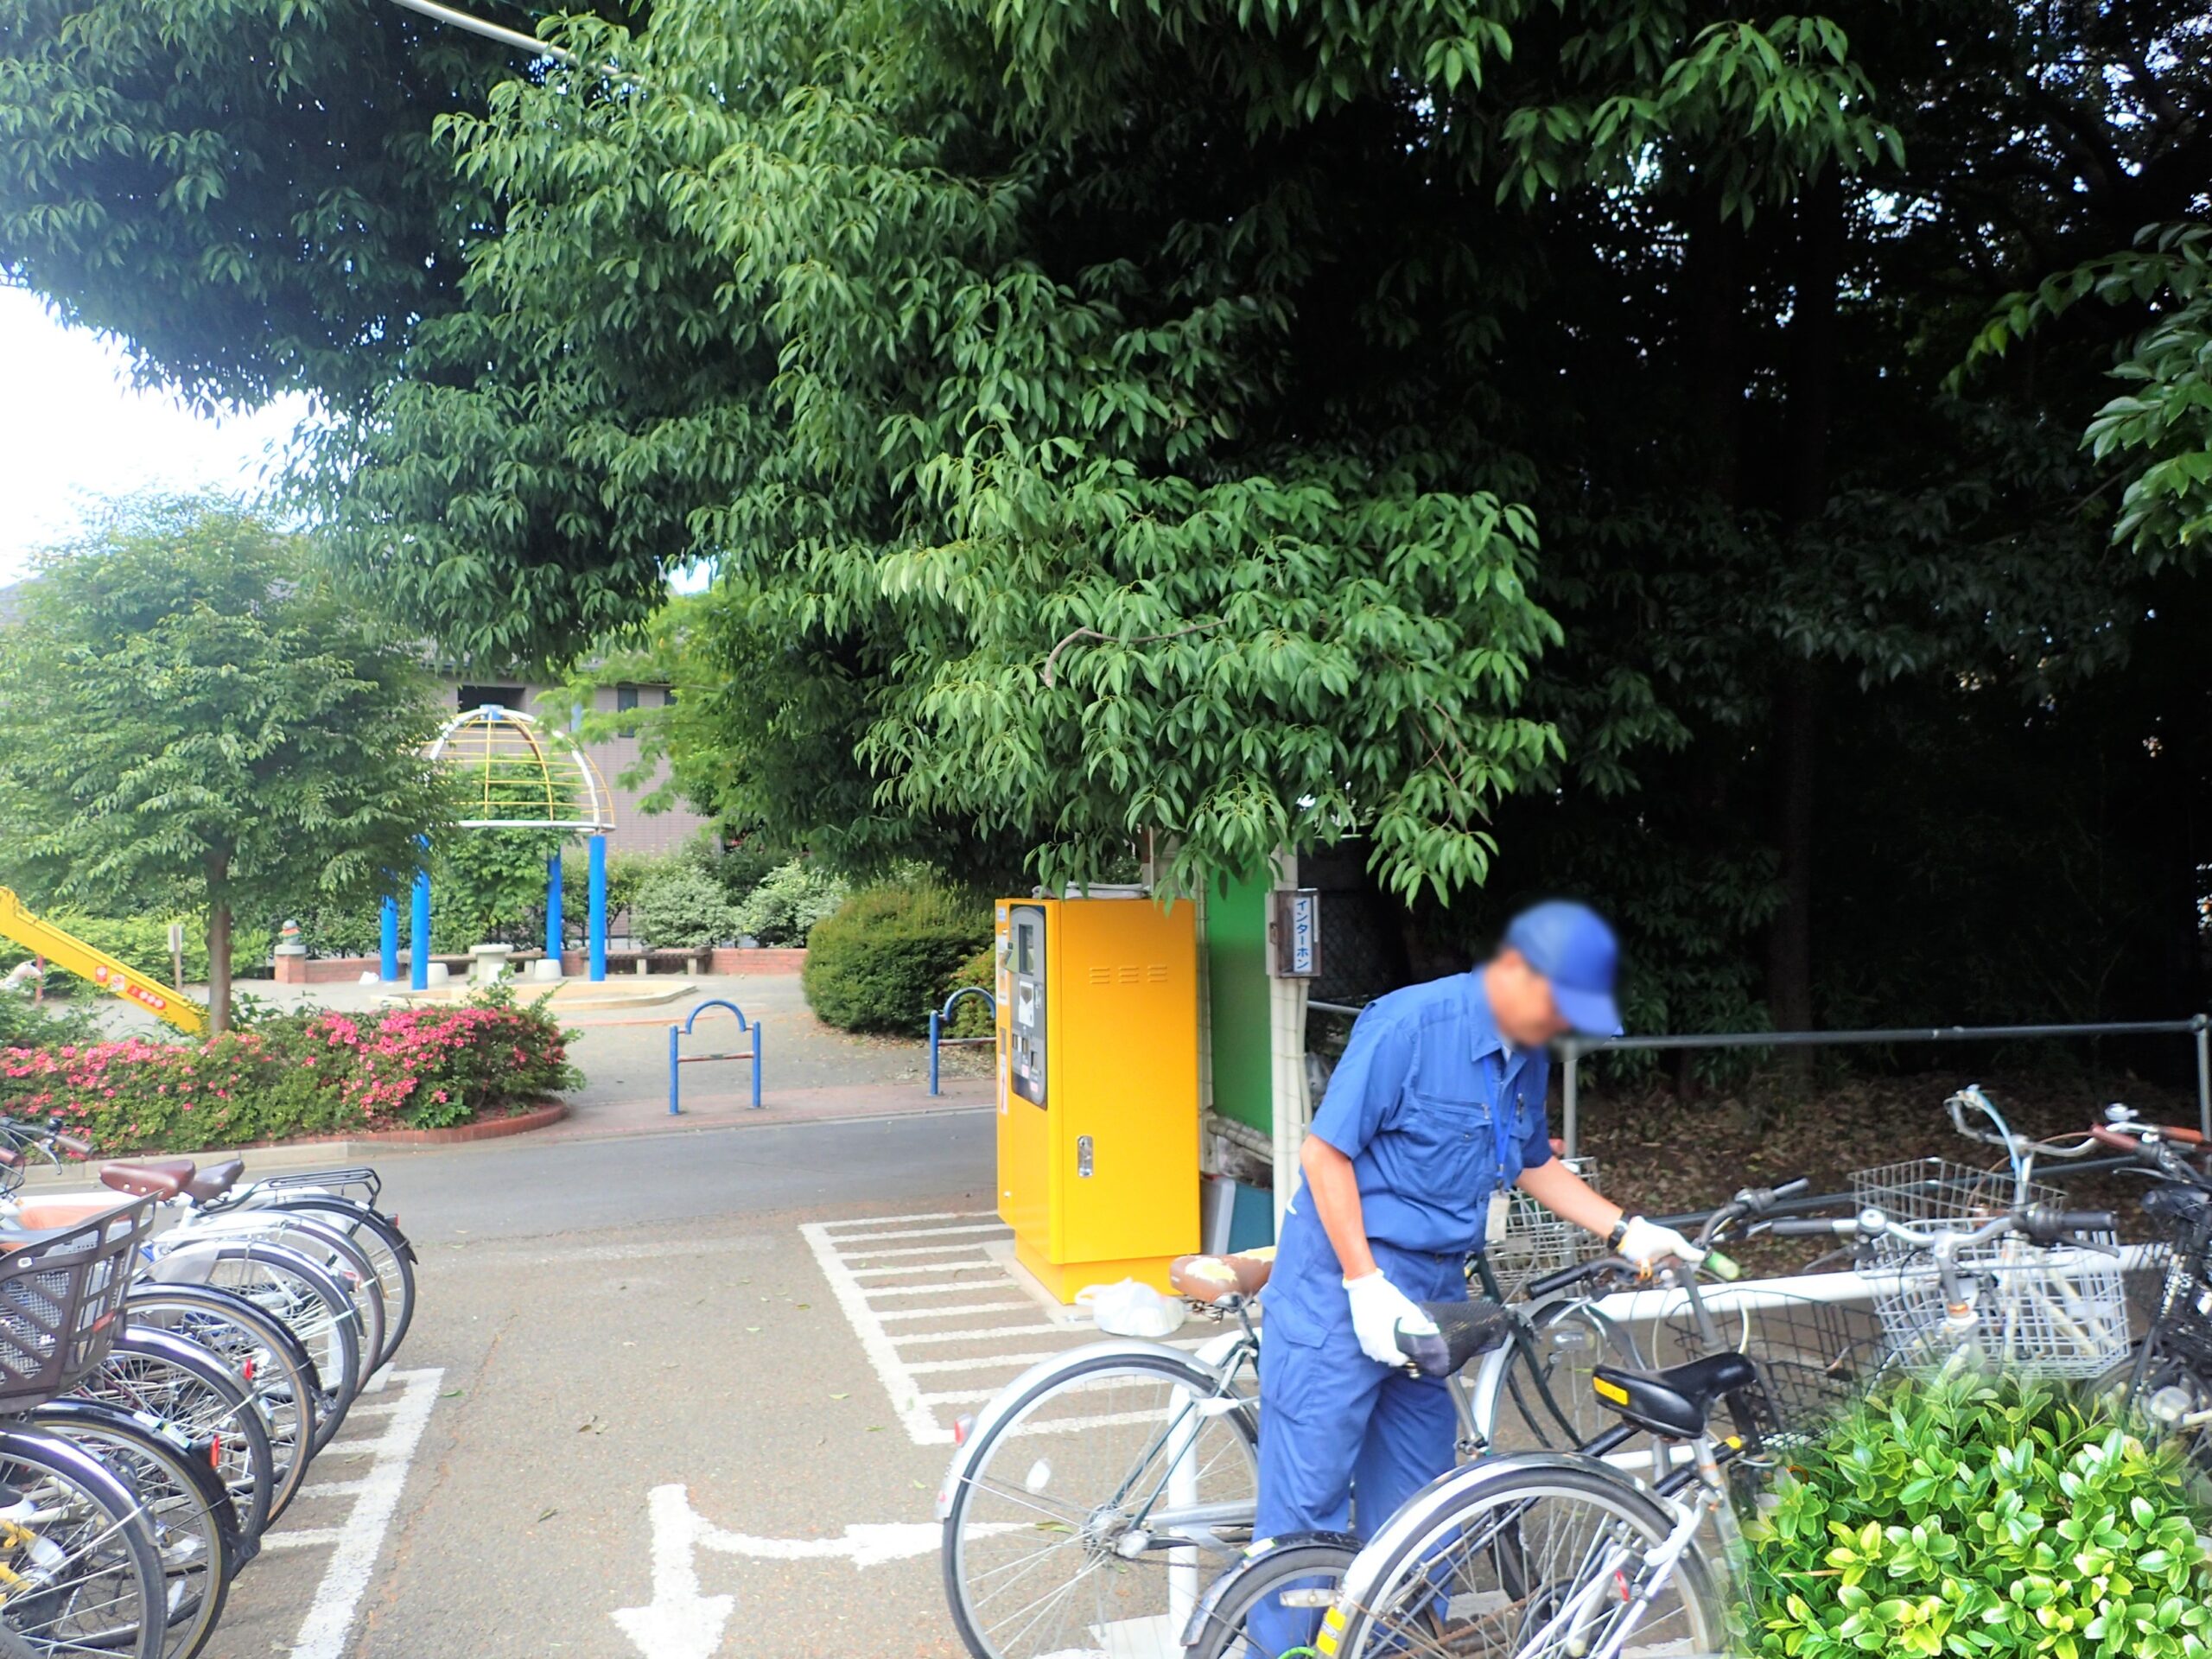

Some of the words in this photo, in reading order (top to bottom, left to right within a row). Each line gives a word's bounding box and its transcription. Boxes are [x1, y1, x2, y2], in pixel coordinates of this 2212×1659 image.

[1296, 900, 1309, 969] インターホン
